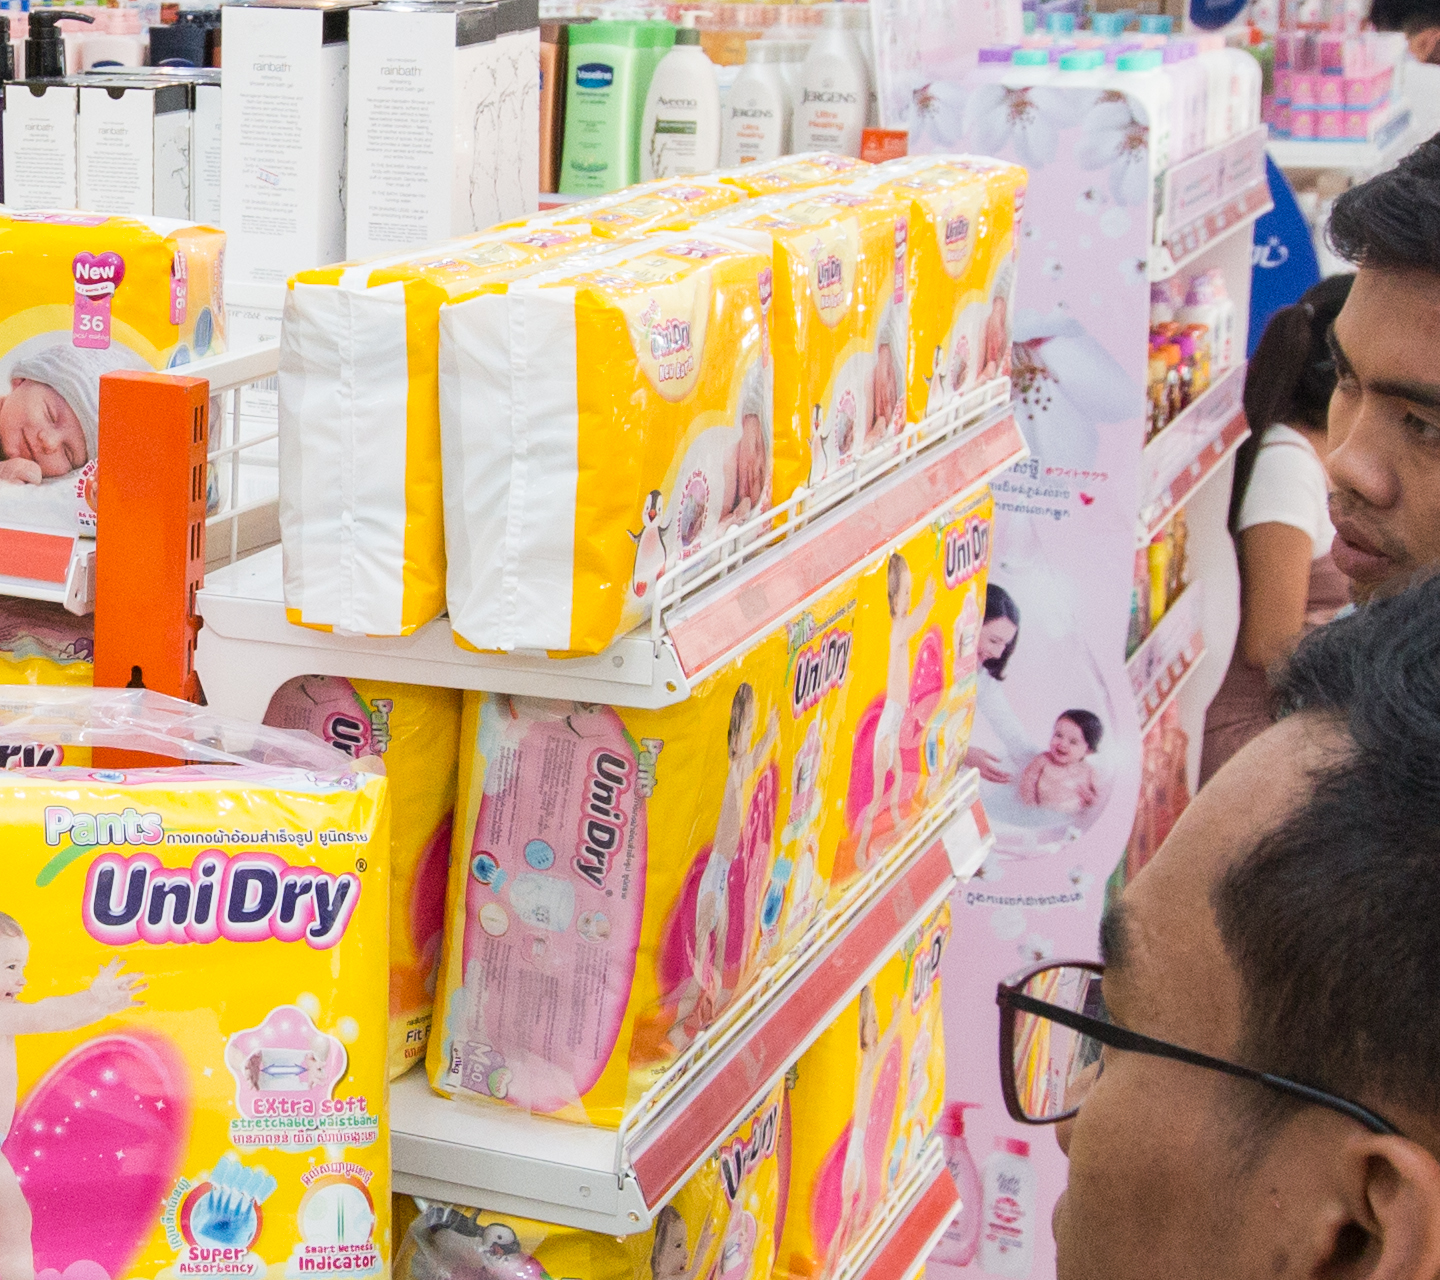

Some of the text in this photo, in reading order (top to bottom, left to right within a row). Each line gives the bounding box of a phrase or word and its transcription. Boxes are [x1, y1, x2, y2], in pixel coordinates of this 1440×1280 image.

[252, 61, 291, 73] rainbath
[380, 64, 423, 77] rainbath
[655, 96, 698, 108] Aveeno
[800, 87, 858, 105] JERGENS
[731, 106, 775, 120] JERGENS
[75, 261, 116, 281] New
[79, 313, 105, 333] 36
[793, 631, 854, 713] UniDry
[44, 806, 164, 846] Pants
[575, 752, 628, 886] UniDry
[165, 829, 314, 850] กางเกงผ้าอ้อมสำเร็จรูป
[87, 856, 356, 944] UniDry
[405, 1026, 423, 1042] Fit
[466, 1039, 495, 1084] M 60
[252, 1095, 368, 1117] Extra soft
[230, 1114, 379, 1129] stretchable waistband
[188, 1246, 245, 1264] Super
[304, 1243, 374, 1254] Smart Wetness
[179, 1262, 255, 1275] Absorbency
[297, 1253, 378, 1271] Indicator
